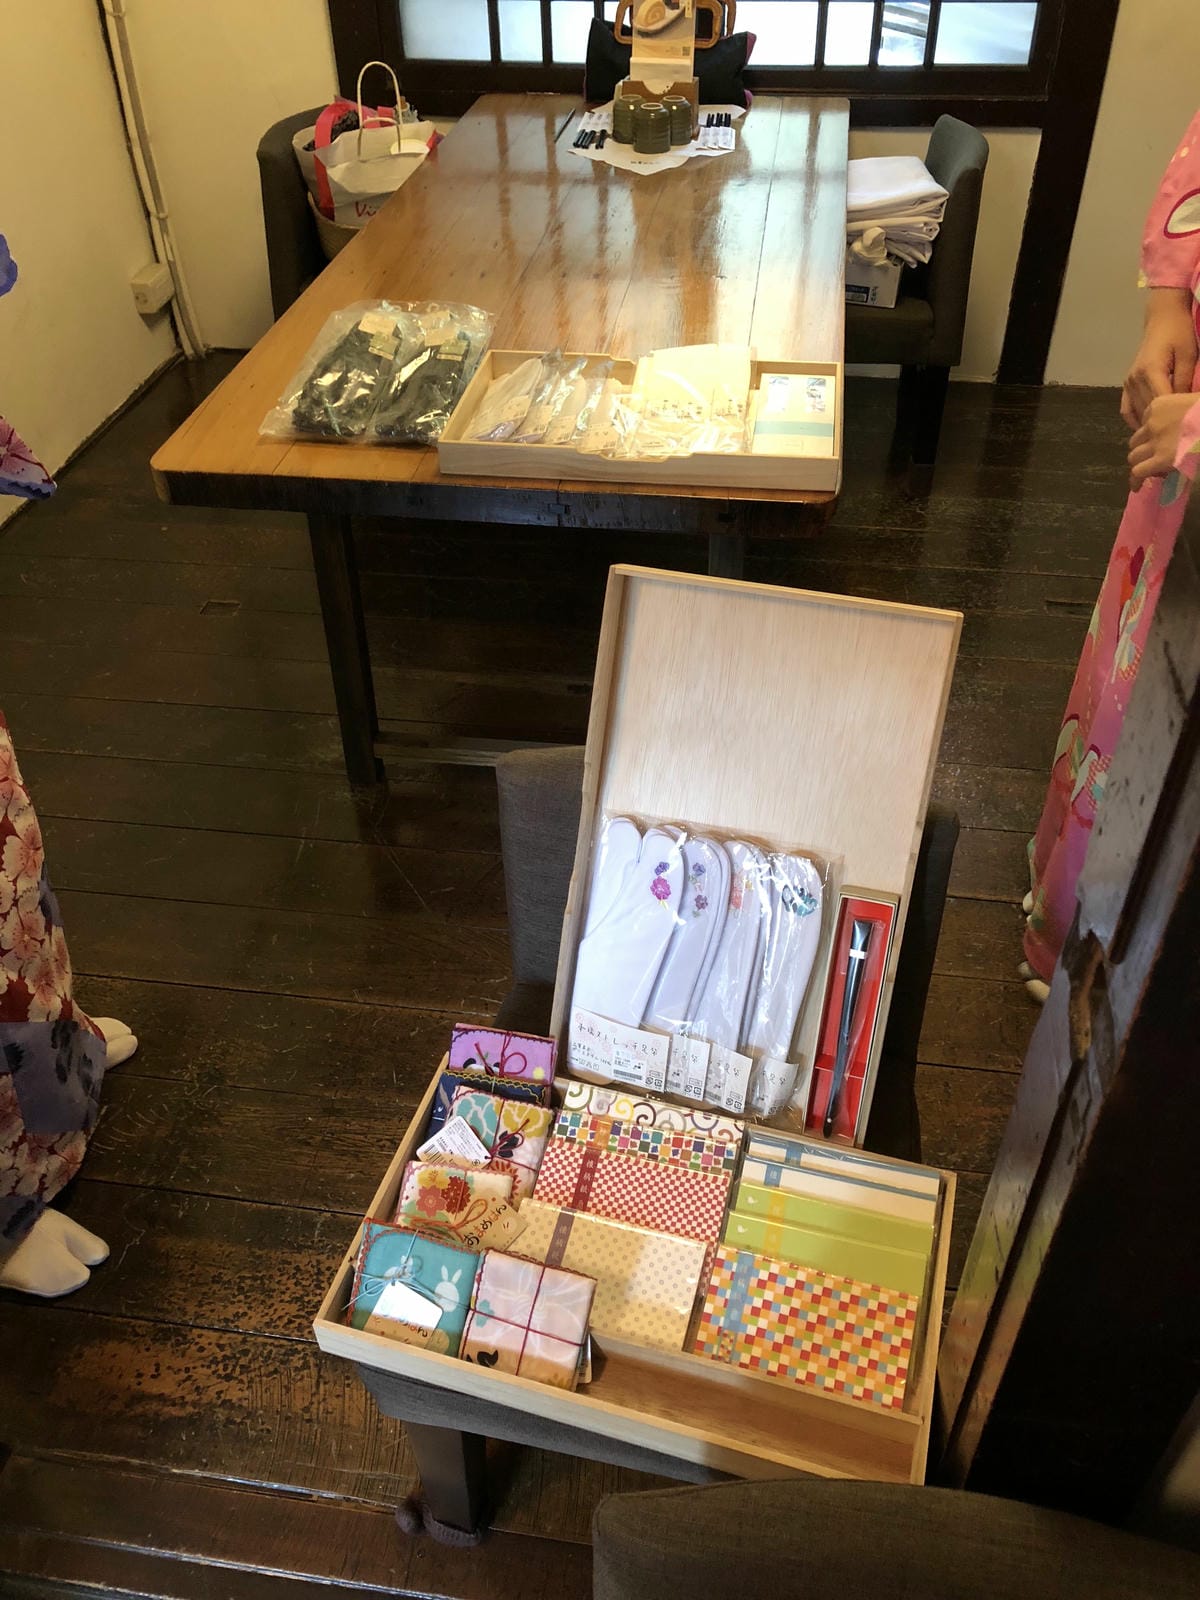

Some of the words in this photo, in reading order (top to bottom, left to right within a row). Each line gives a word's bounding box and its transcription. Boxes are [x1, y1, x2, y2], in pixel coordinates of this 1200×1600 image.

[463, 1203, 508, 1248] おまめはん
